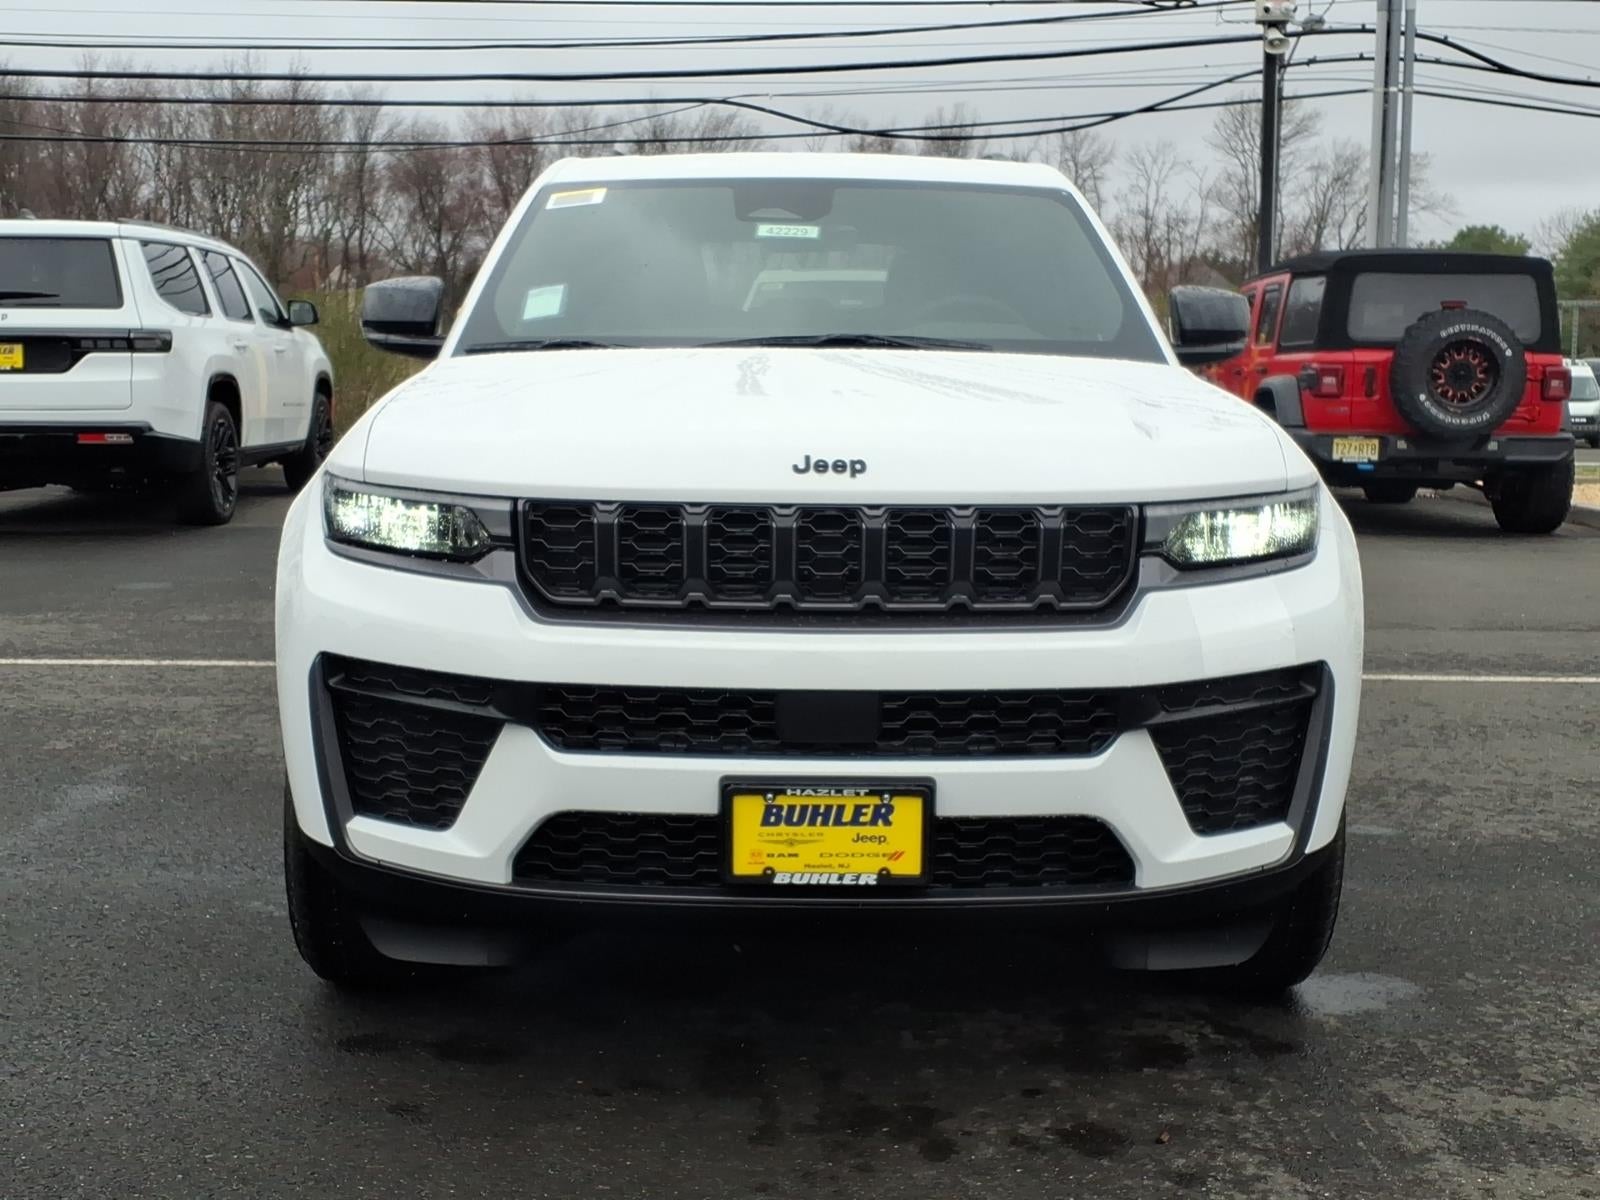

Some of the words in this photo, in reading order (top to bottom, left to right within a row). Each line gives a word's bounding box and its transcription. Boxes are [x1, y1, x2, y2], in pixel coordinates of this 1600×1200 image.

[766, 226, 809, 236] 42229
[792, 454, 867, 479] Jeep
[786, 789, 870, 797] HAZLET
[760, 803, 895, 827] BUHLER
[851, 832, 887, 845] Jeep
[773, 872, 878, 885] BUHLER
